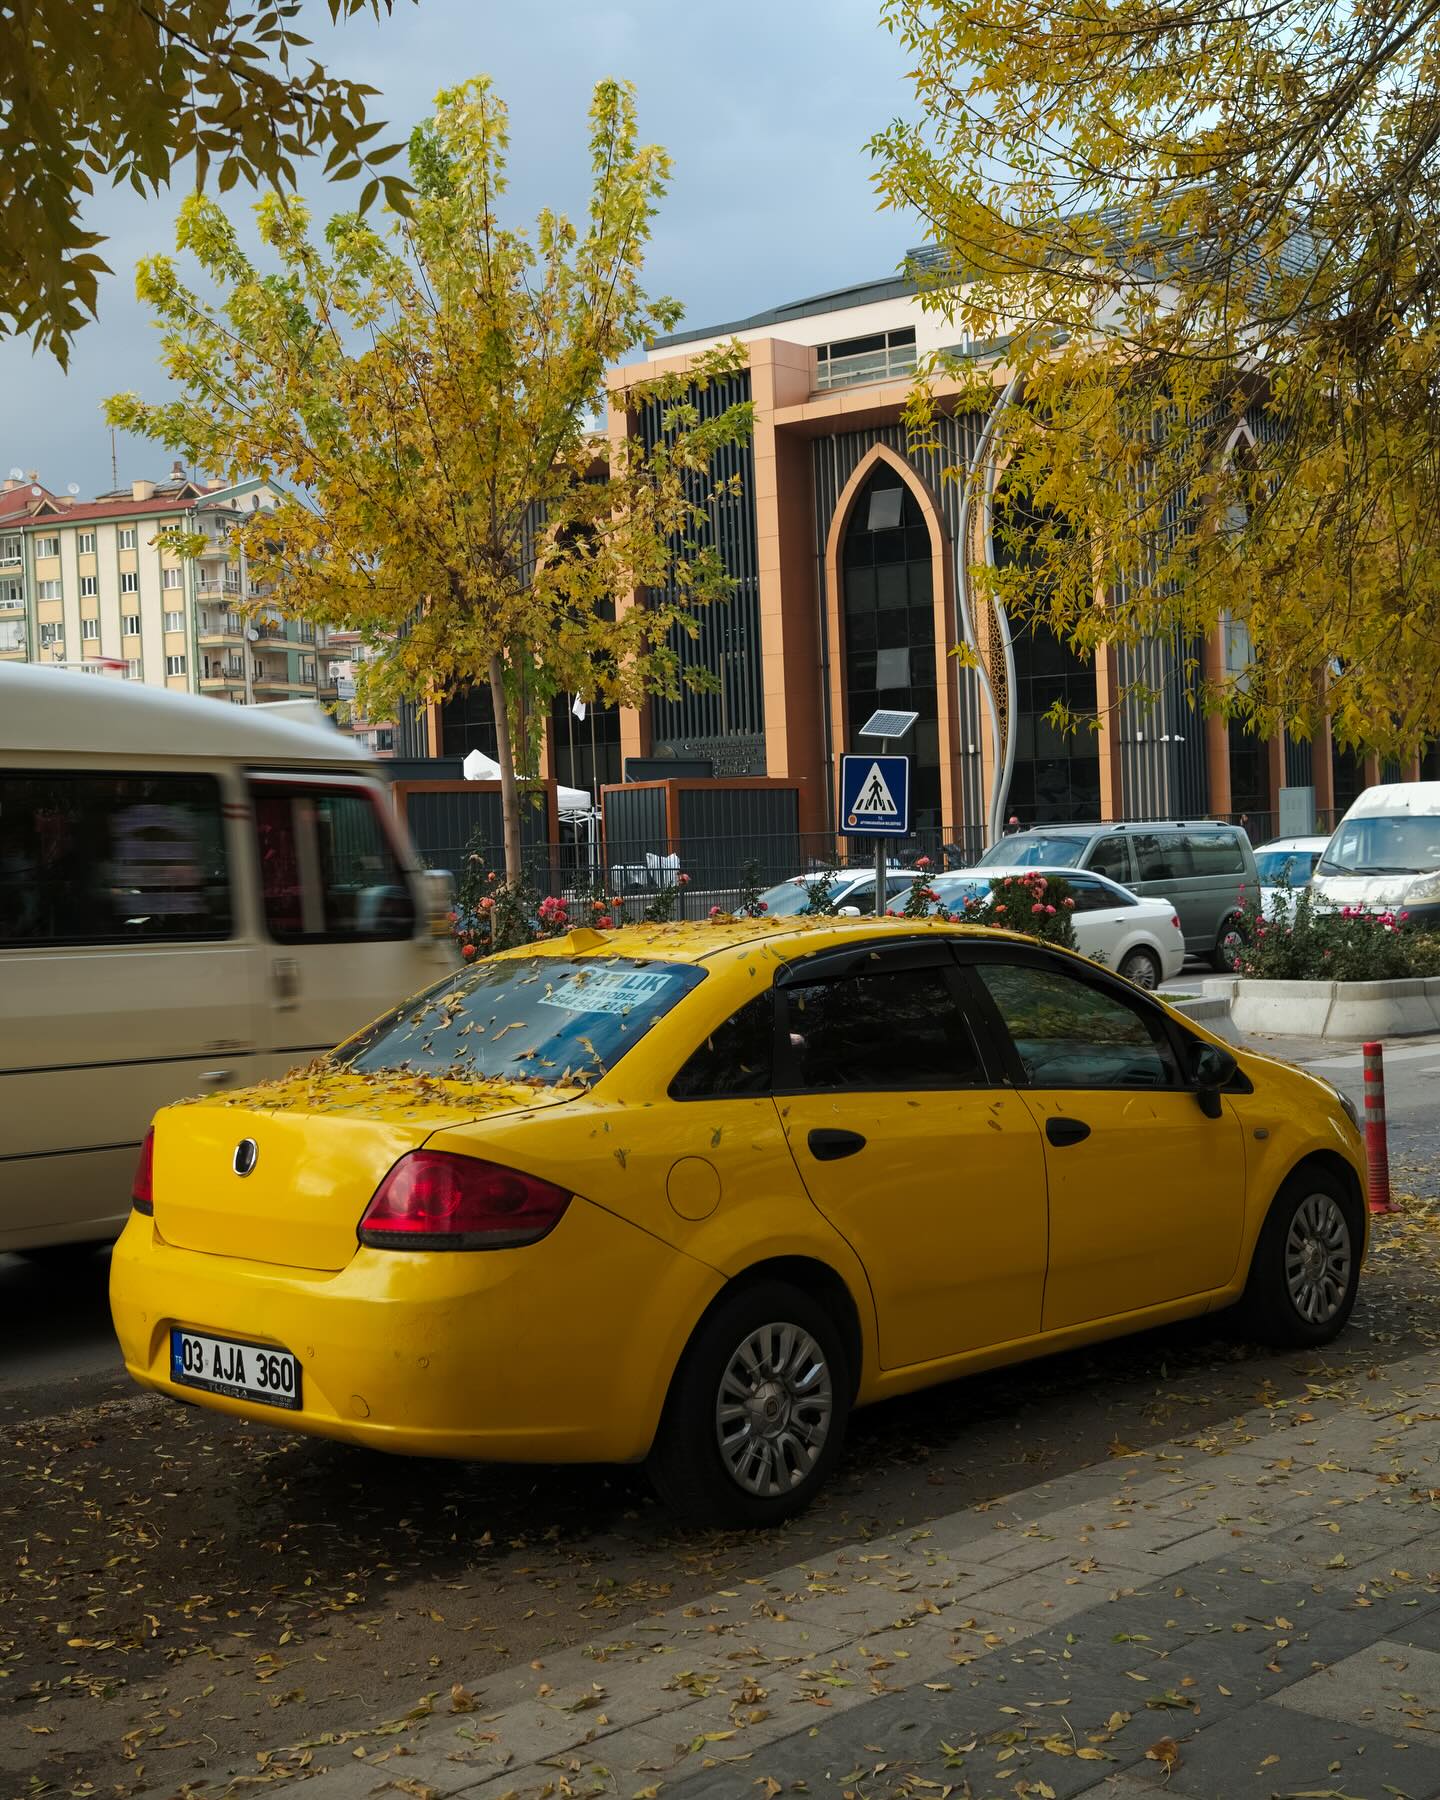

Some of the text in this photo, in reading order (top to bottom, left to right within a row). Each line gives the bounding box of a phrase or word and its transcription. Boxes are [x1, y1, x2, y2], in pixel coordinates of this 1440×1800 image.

[596, 990, 639, 1001] MODEL
[182, 1338, 294, 1392] 03 AJA 360
